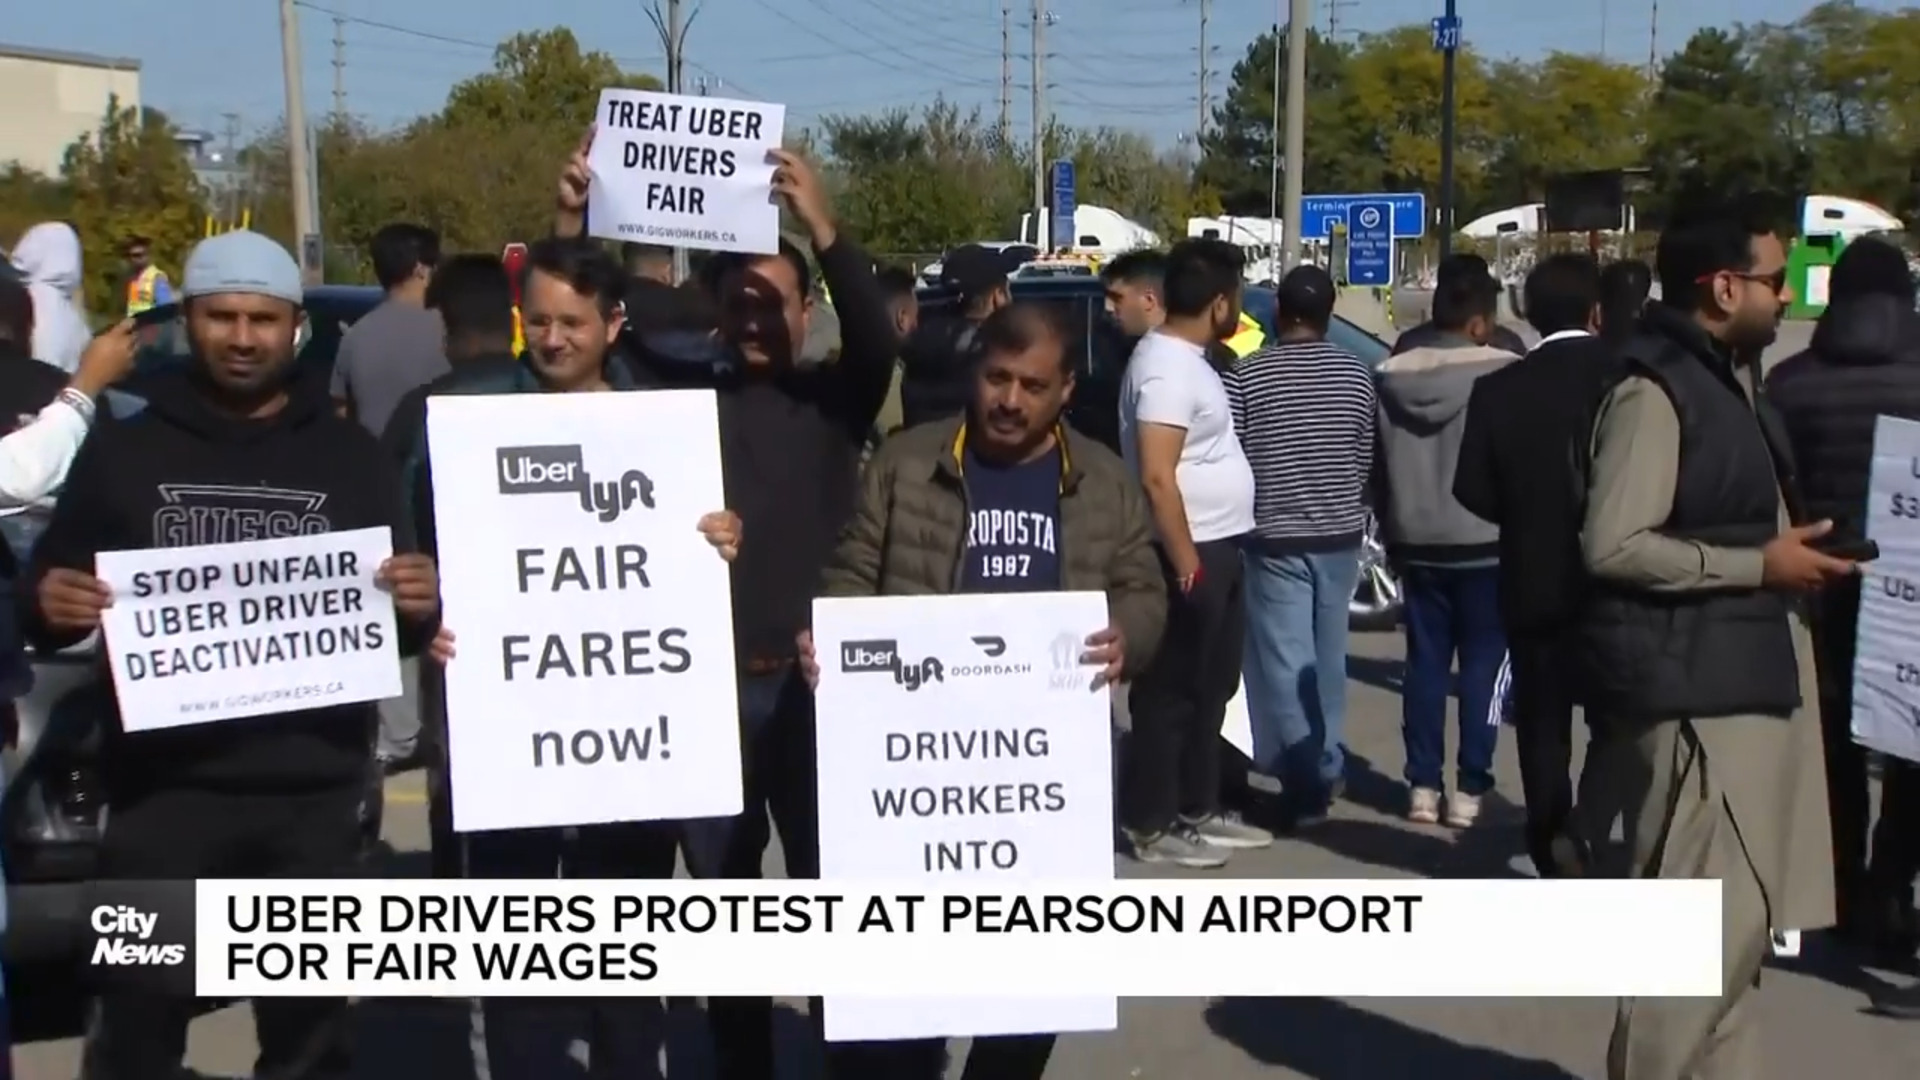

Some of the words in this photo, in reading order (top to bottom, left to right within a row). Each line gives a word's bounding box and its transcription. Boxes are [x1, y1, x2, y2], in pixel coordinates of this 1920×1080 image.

[607, 100, 683, 132] TREAT
[688, 107, 762, 140] UBER
[623, 141, 736, 178] DRIVERS
[646, 182, 705, 215] FAIR
[617, 223, 738, 243] WWW.GIGWORKERS.CA
[502, 456, 578, 485] Uber
[581, 469, 656, 523] lyft
[132, 565, 222, 598] STOP
[233, 551, 359, 587] UNFAIR
[516, 544, 652, 593] FAIR
[982, 553, 1031, 578] 1987
[134, 601, 228, 638] UBER
[240, 587, 363, 626] DRIVER
[126, 622, 384, 681] DEACTIVATIONS
[501, 627, 692, 682] FARES
[844, 647, 894, 667] Uber
[895, 656, 944, 692] lyft
[951, 663, 1032, 677] DOORDASH
[531, 714, 671, 768] now!
[885, 728, 1049, 762] DRIVING
[871, 781, 1066, 819] WORKERS
[924, 839, 1019, 873] INTO
